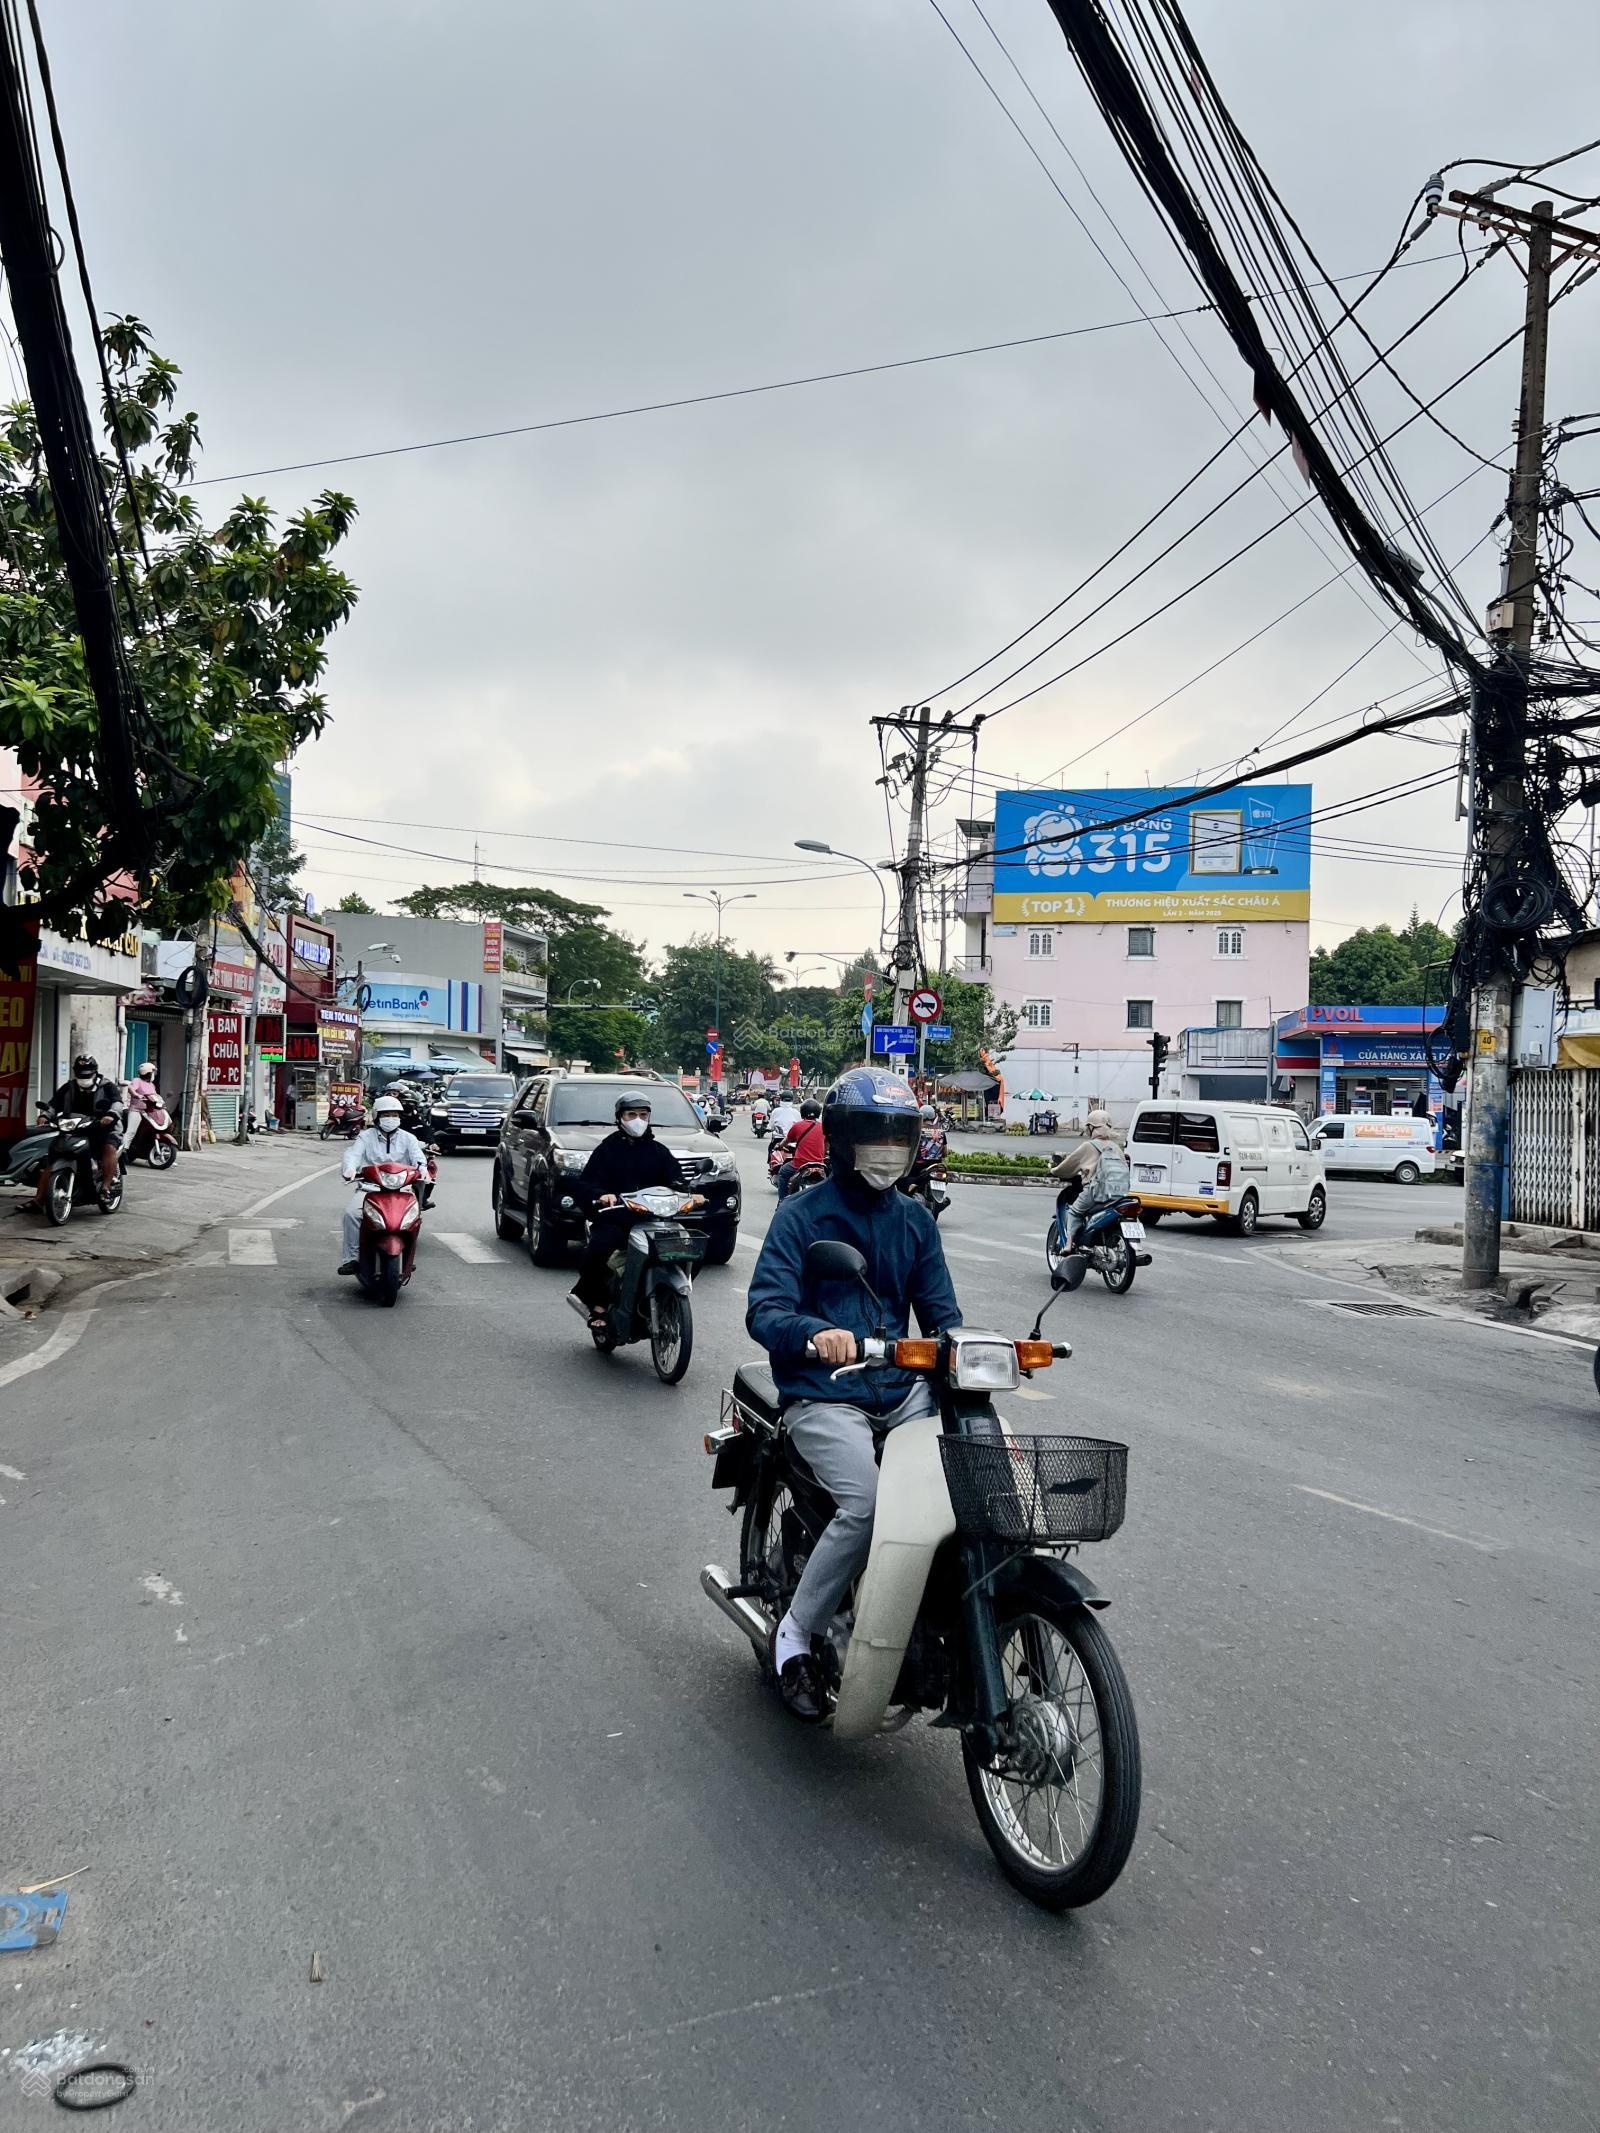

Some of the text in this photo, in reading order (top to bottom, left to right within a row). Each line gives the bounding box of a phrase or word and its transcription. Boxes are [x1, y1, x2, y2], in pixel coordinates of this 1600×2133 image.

[1088, 834, 1170, 873] 315
[1031, 898, 1076, 912] TOP 1
[1106, 897, 1151, 907] THƯƠNG
[1153, 896, 1179, 909] HIỆU
[1182, 895, 1208, 907] XUẤT
[1237, 895, 1268, 906] CHÂU
[1312, 1006, 1364, 1022] PVOIL
[213, 1040, 239, 1059] CHỮA
[1358, 1049, 1378, 1060] CỬA
[1380, 1050, 1407, 1060] HÀNG
[228, 1067, 239, 1083] PC
